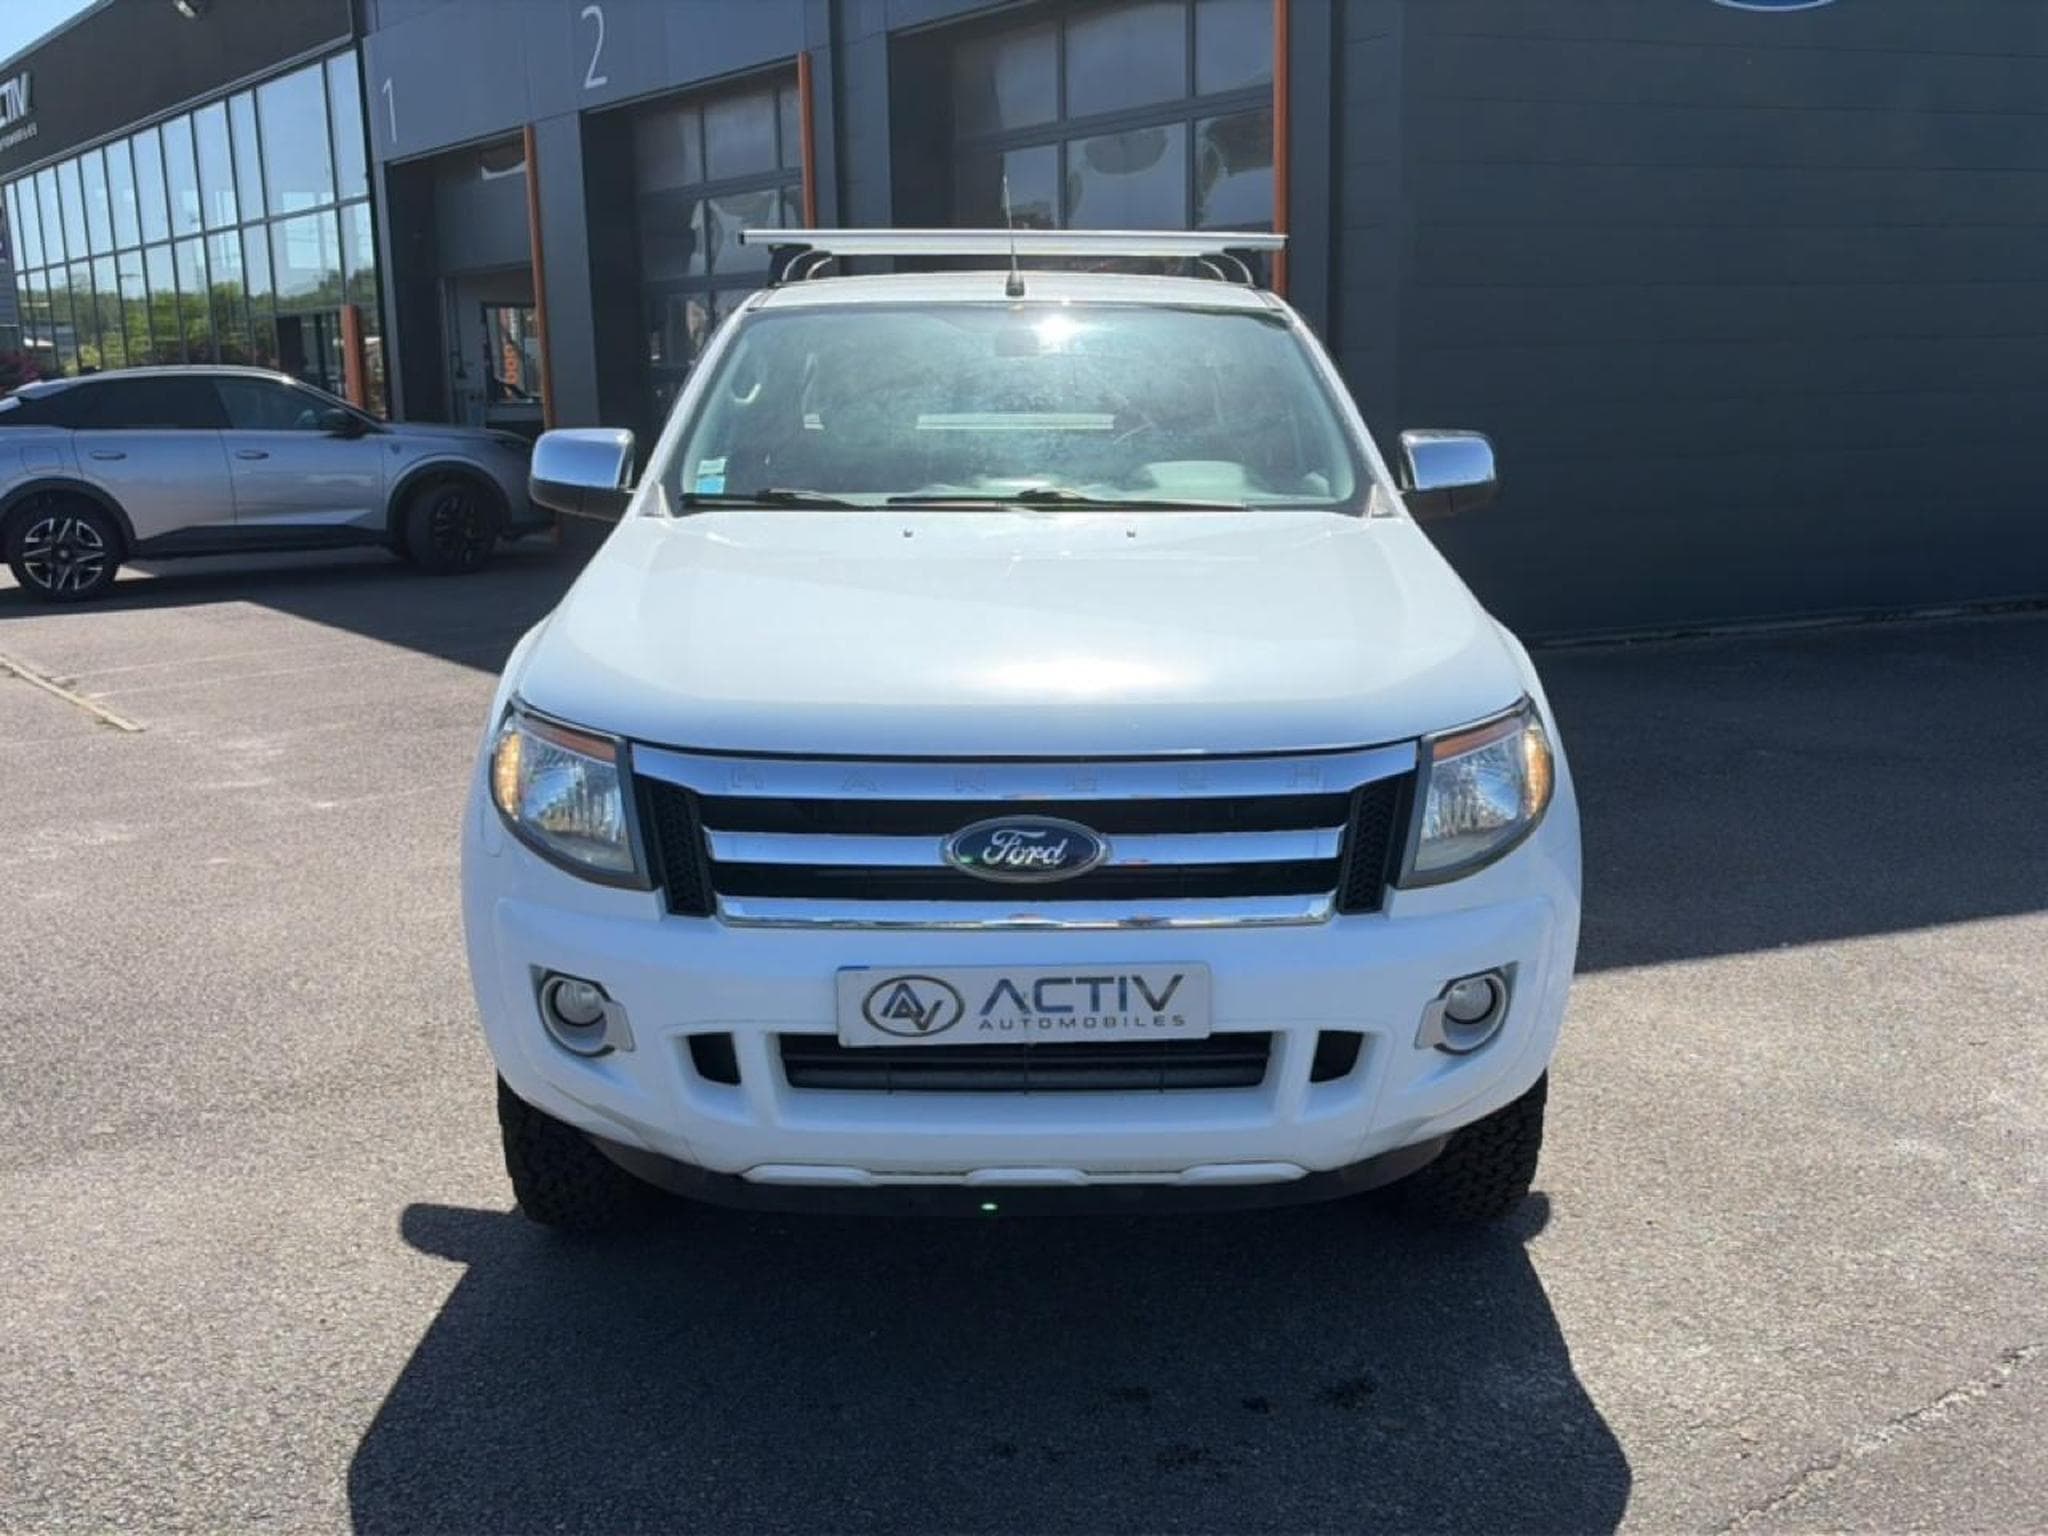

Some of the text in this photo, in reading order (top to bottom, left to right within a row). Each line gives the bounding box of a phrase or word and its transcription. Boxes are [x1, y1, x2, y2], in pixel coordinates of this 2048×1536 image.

[581, 5, 607, 89] 2
[382, 77, 397, 144] 1
[983, 829, 1068, 865] Ford
[979, 974, 1184, 1016] ACTIV
[978, 1014, 1187, 1031] AUTOMOBILES
